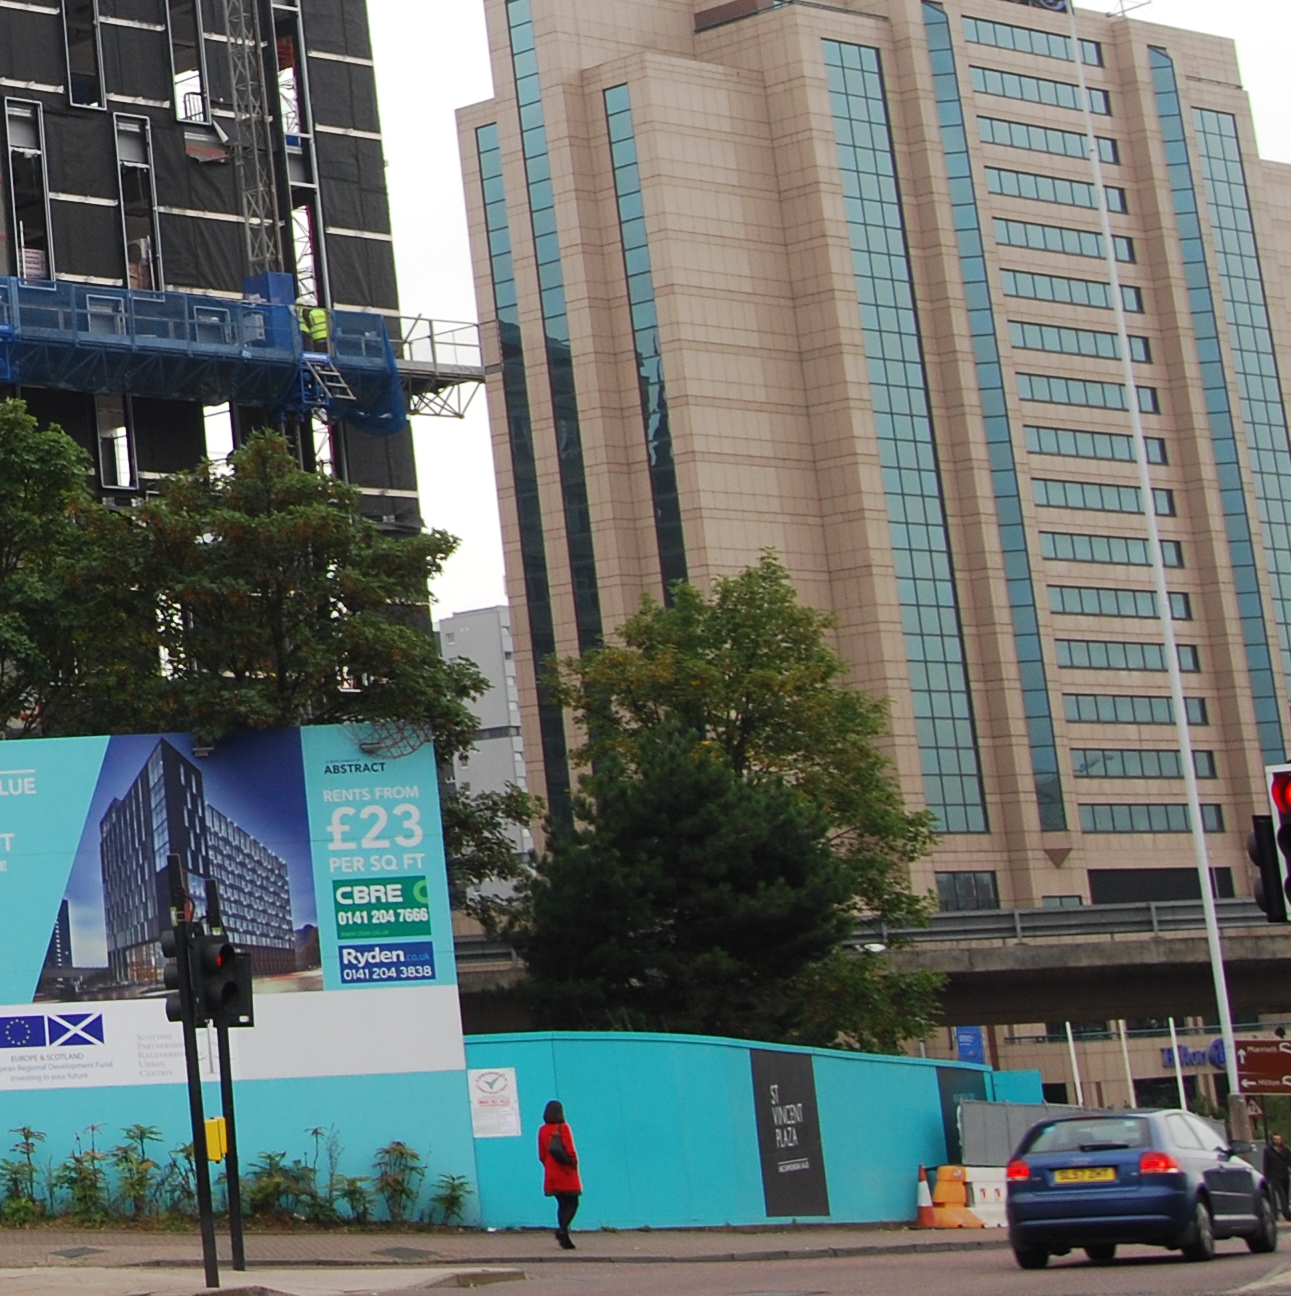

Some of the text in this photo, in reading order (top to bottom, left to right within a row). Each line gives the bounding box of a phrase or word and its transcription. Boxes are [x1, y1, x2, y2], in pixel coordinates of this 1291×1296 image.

[324, 762, 386, 775] ABSTRACT
[323, 785, 419, 802] RENTS FROM
[326, 803, 424, 850] £23
[329, 853, 425, 873] PER SQ FT
[336, 884, 403, 904] CBRE
[338, 908, 428, 925] 0141 204 7666
[343, 965, 432, 980] 0141 204 3838
[11, 1055, 37, 1063] EUROPE
[46, 1053, 84, 1061] SCOTLAND
[18, 1063, 47, 1073] Regional
[48, 1062, 94, 1073] Development
[95, 1061, 113, 1069] Fund
[770, 1084, 779, 1105] ST
[771, 1103, 803, 1125] VINCENT
[775, 1126, 799, 1148] PLAZA
